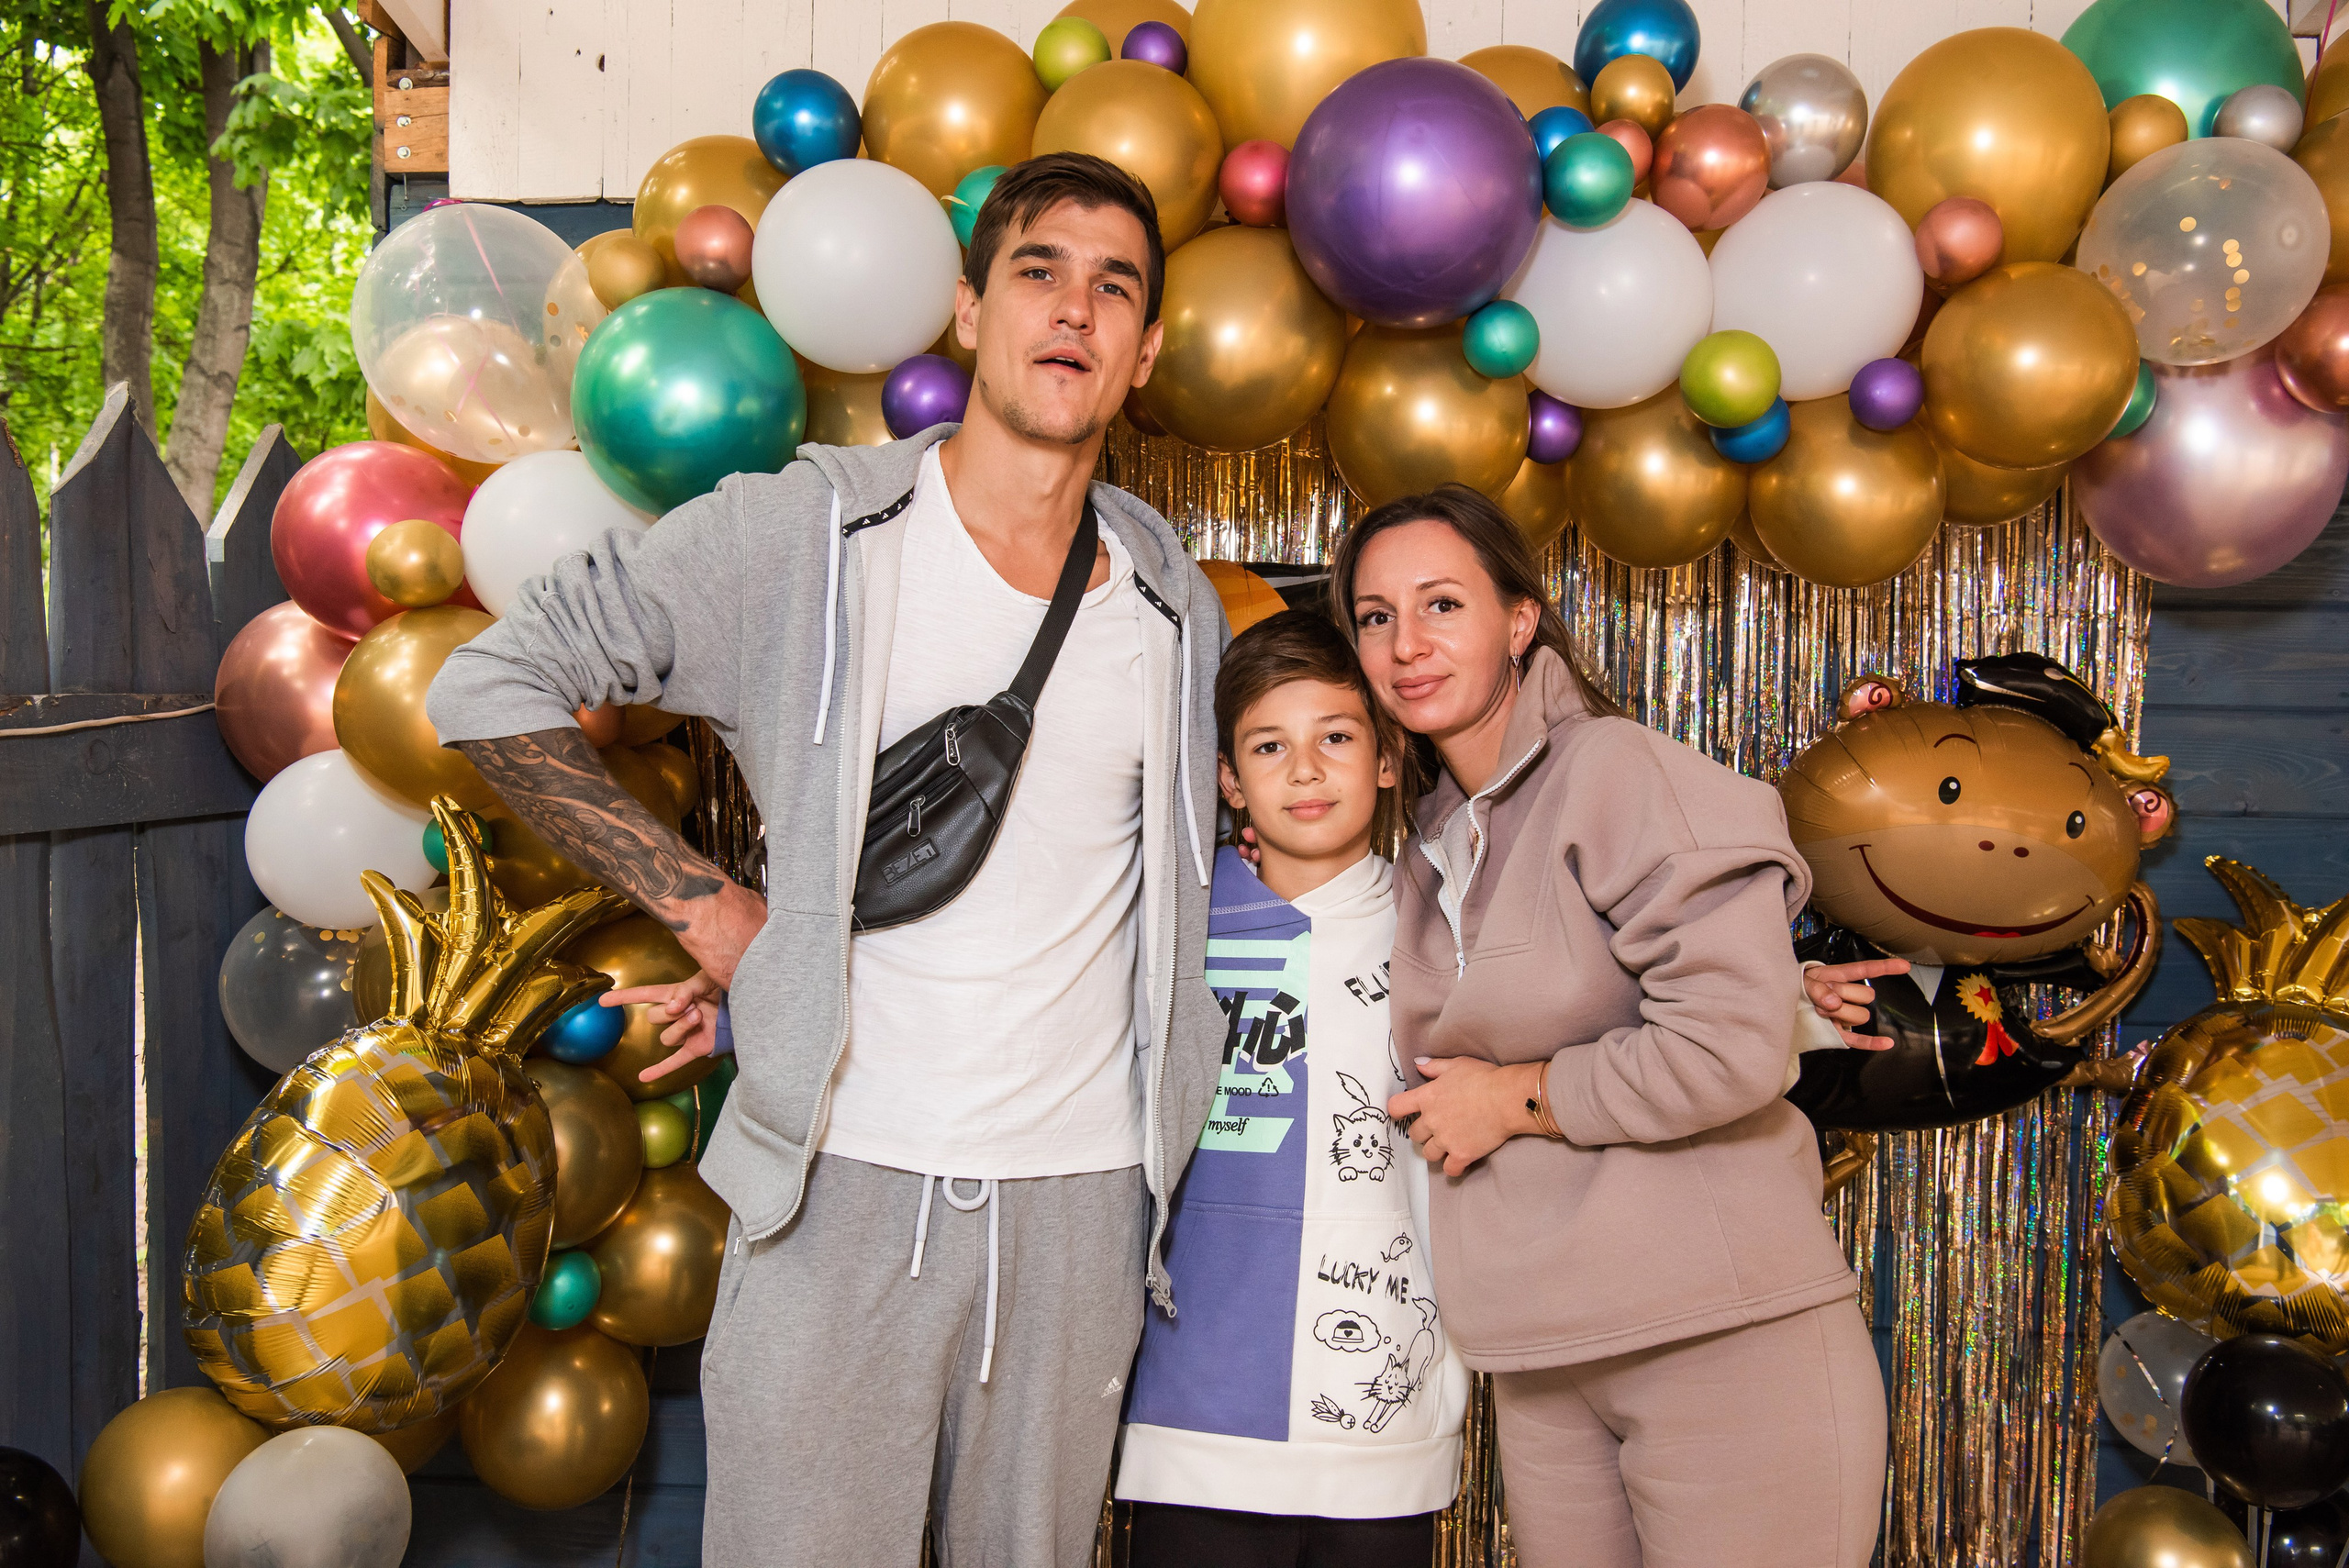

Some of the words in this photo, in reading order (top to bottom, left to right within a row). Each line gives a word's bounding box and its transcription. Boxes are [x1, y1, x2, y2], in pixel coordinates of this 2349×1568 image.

[1344, 961, 1389, 1006] FLU
[1224, 1087, 1252, 1096] MOOD
[1208, 1118, 1250, 1136] myself
[1318, 1253, 1380, 1295] LUCKY
[1385, 1274, 1408, 1304] ME
